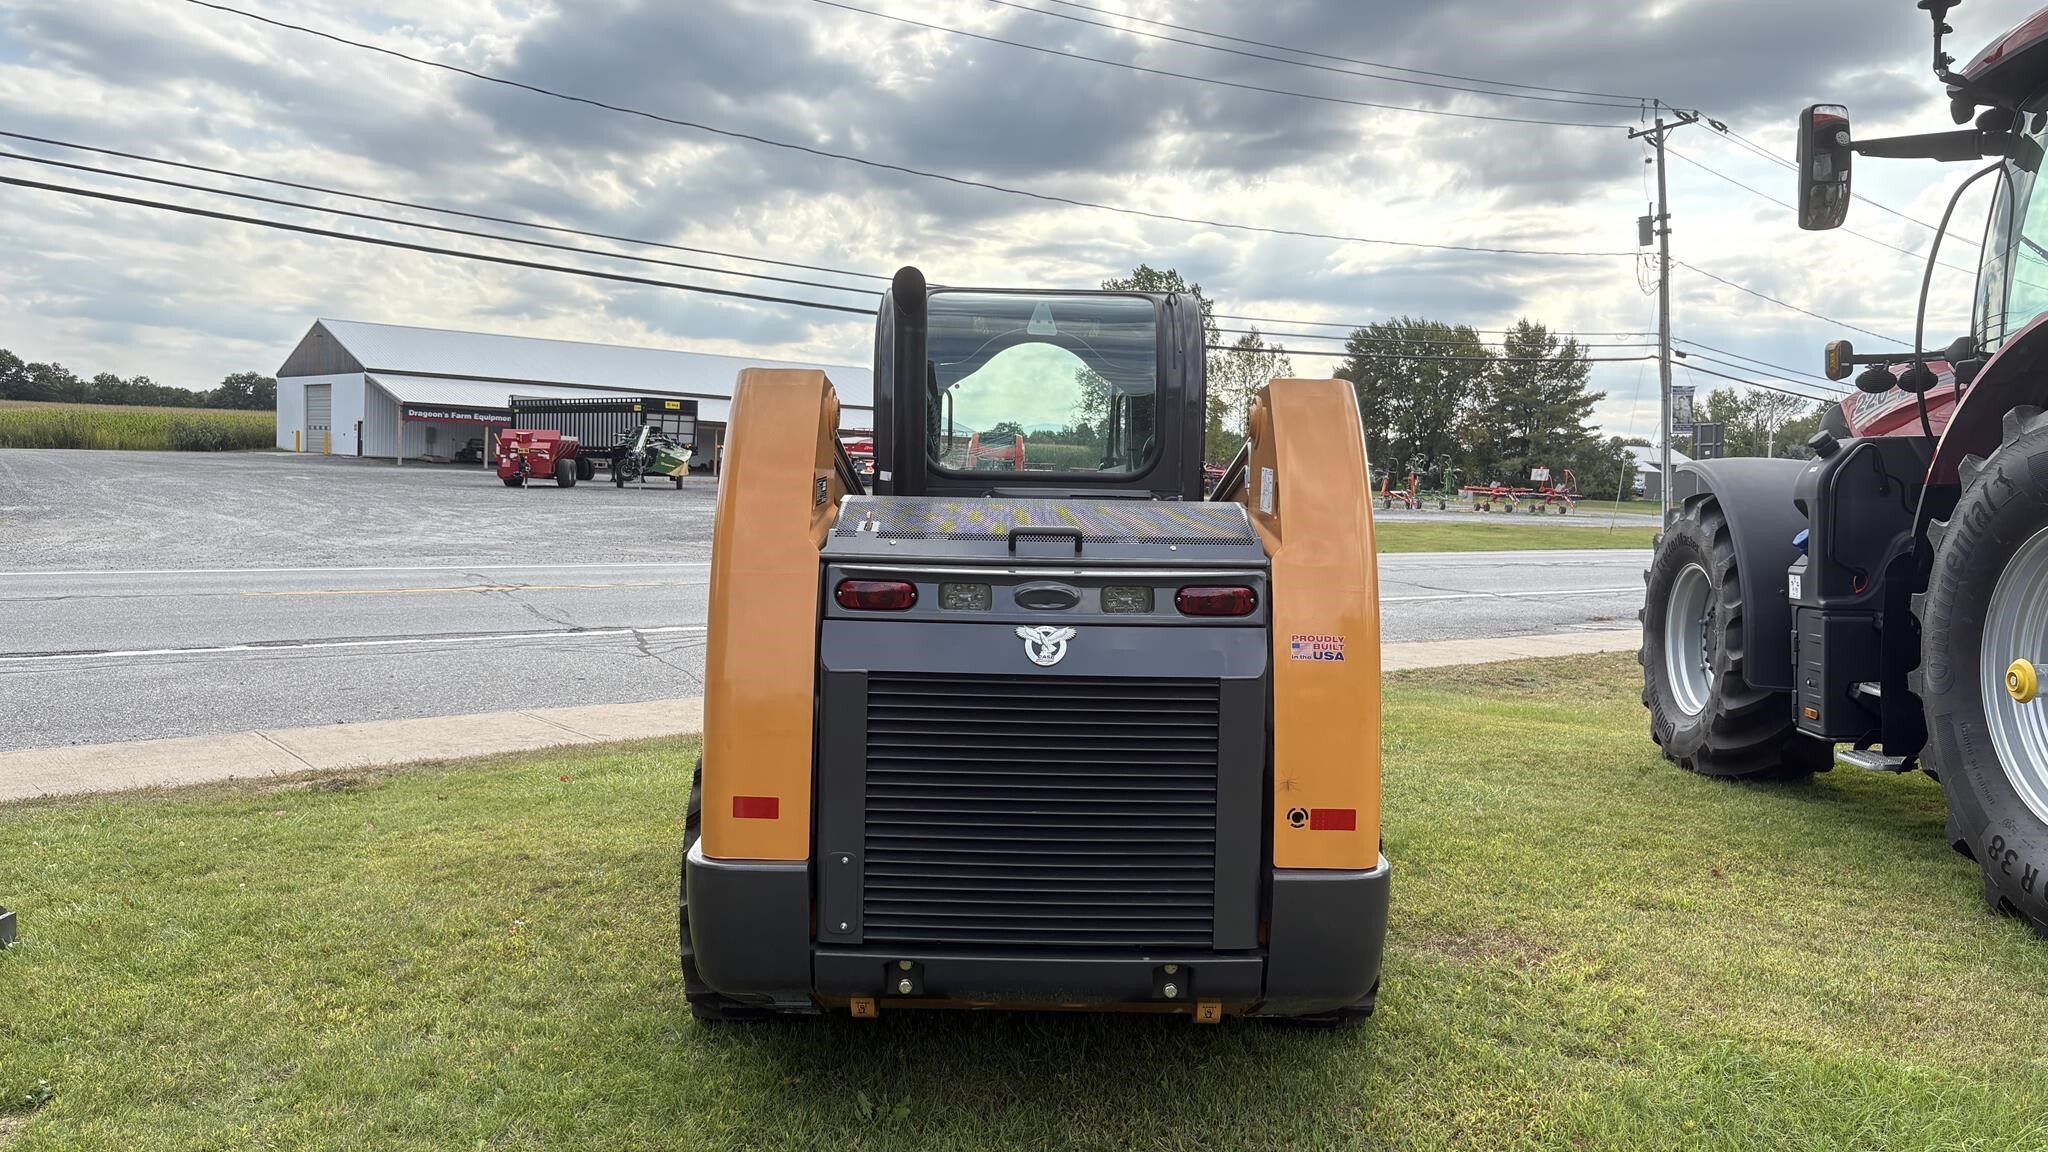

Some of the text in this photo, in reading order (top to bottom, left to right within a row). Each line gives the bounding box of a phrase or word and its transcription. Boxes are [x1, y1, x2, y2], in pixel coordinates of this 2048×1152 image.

[408, 409, 512, 422] Dragoon's Farm Equipmen
[1292, 635, 1344, 643] PROUDLY
[1313, 643, 1344, 651] BUILT
[1313, 651, 1344, 661] USA
